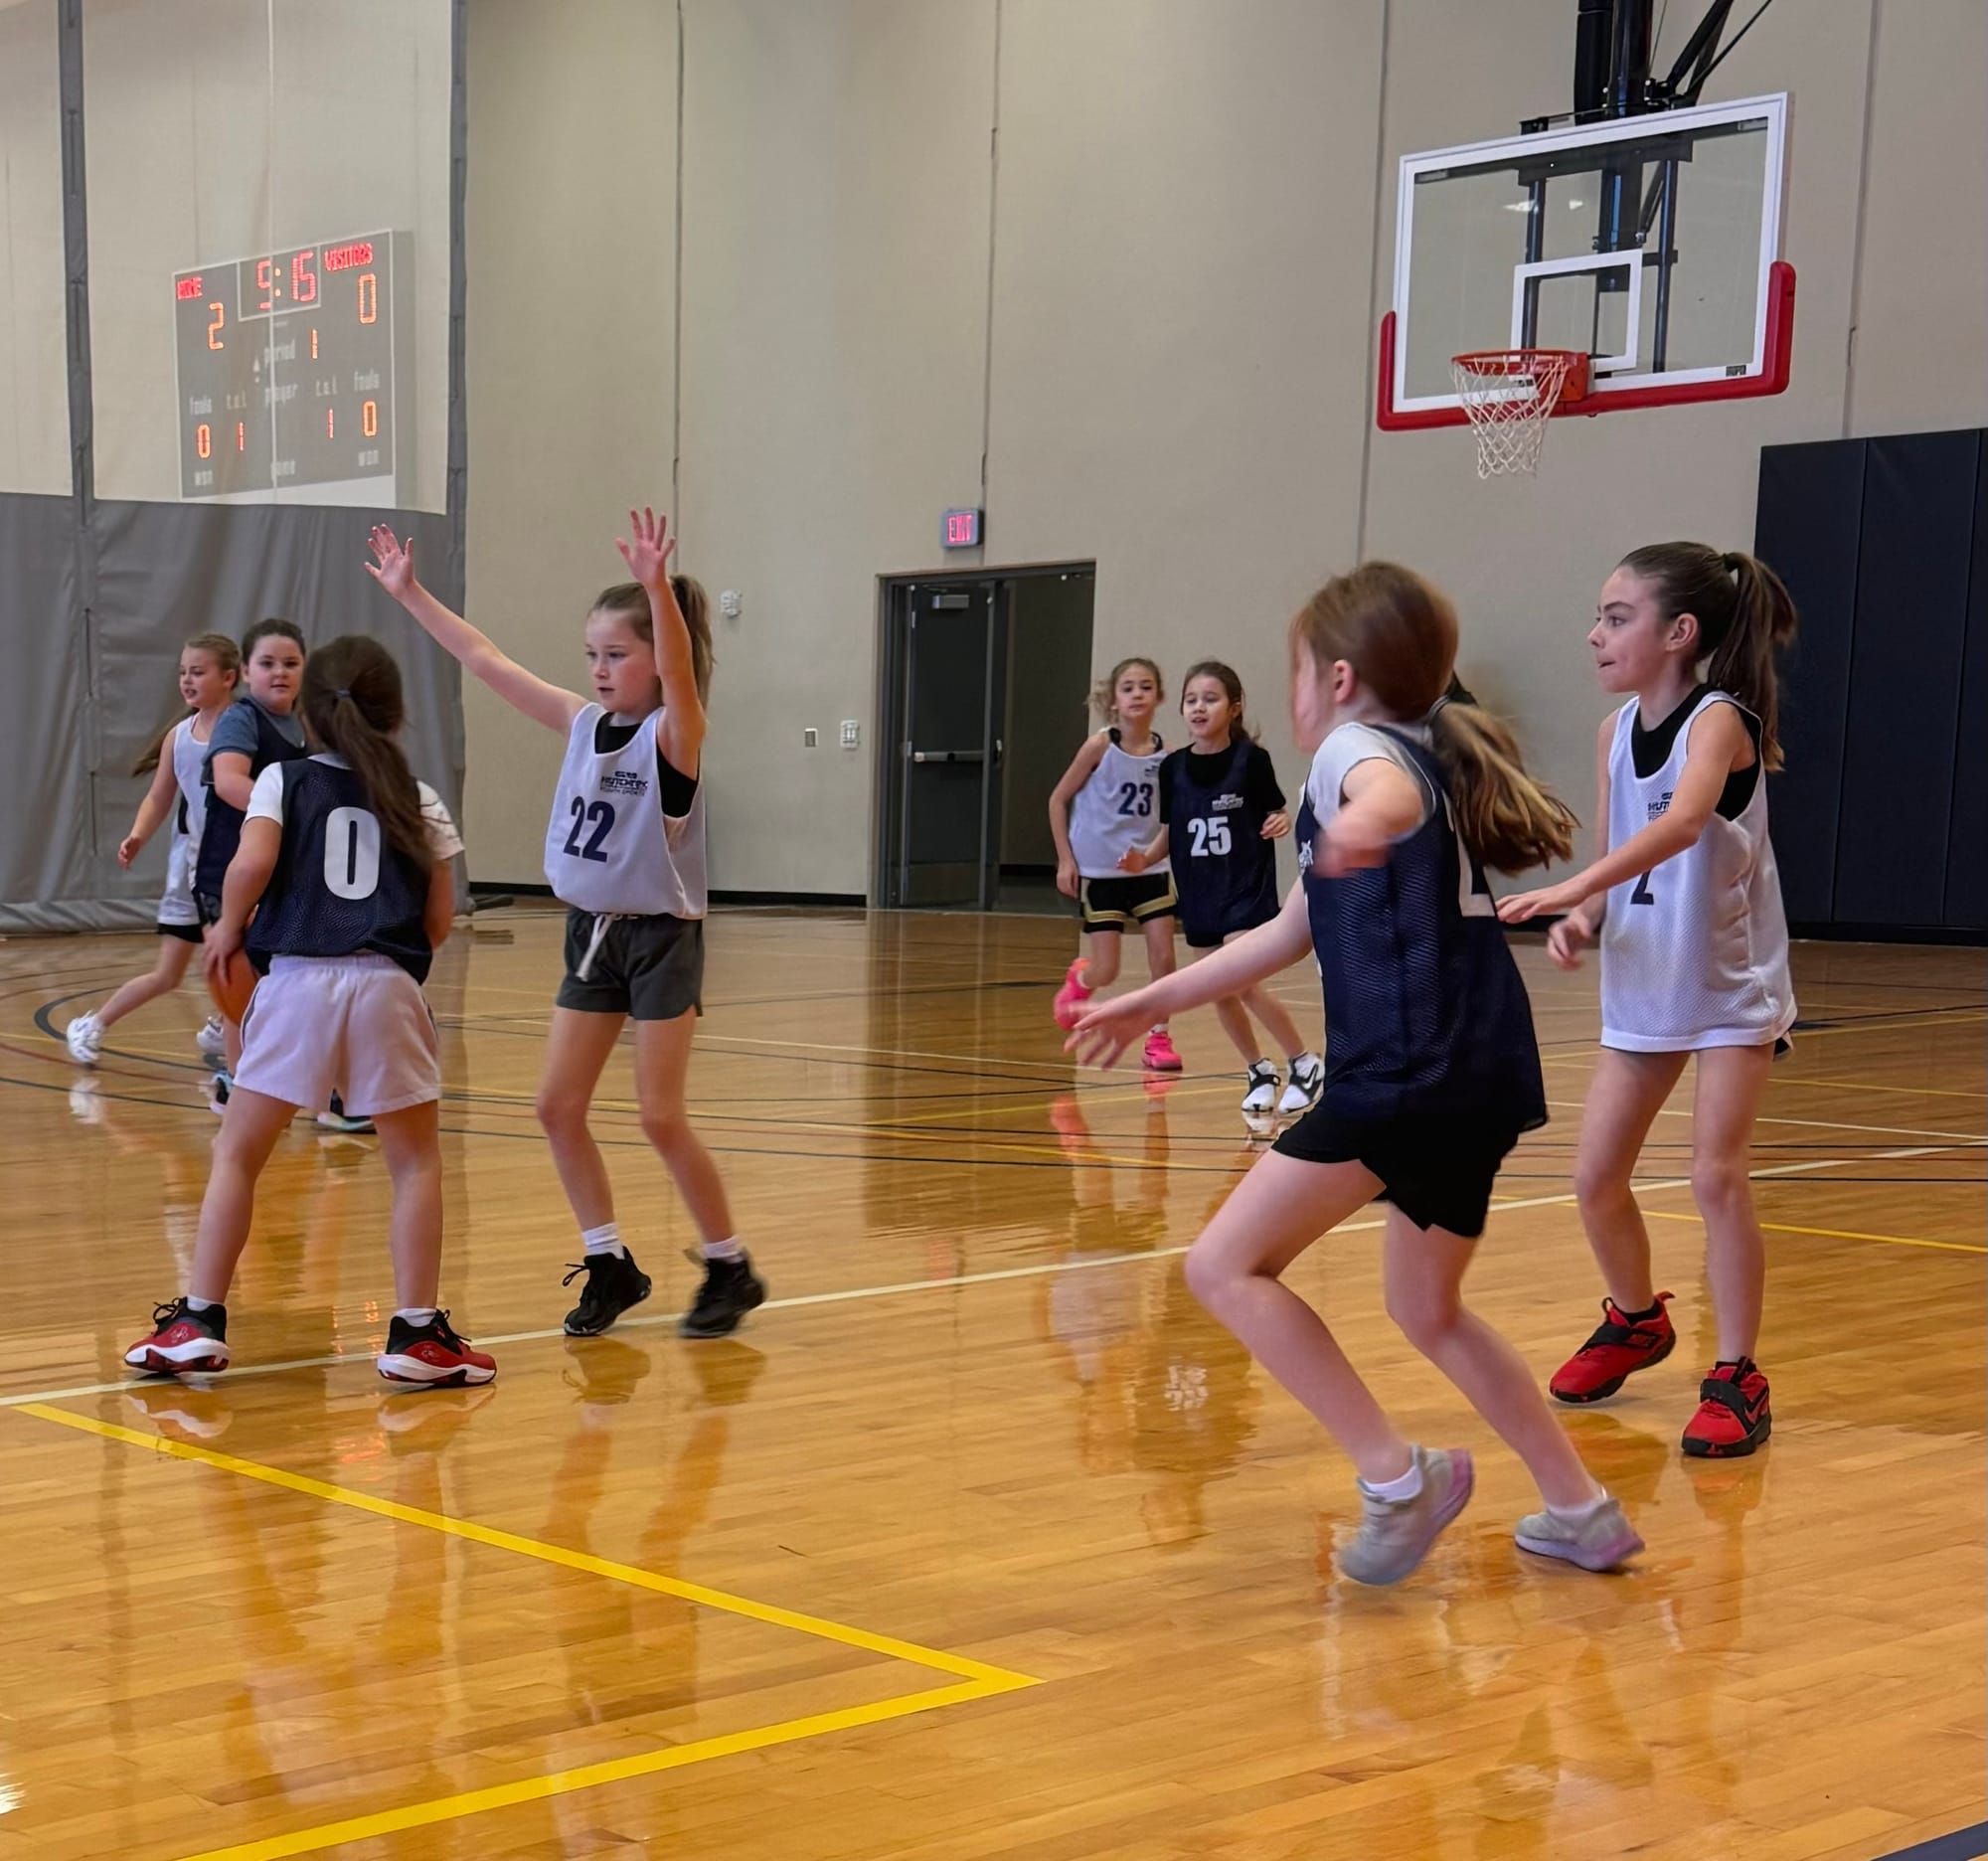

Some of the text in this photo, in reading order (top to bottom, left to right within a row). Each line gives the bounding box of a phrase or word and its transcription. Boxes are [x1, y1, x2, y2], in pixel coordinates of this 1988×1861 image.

[359, 272, 376, 323] 0
[209, 302, 224, 349] 2
[363, 401, 377, 436] 0
[198, 424, 211, 458] 0
[1118, 781, 1154, 817] 23
[563, 795, 616, 863] 22
[1188, 816, 1232, 857] 25
[324, 806, 381, 901] 0
